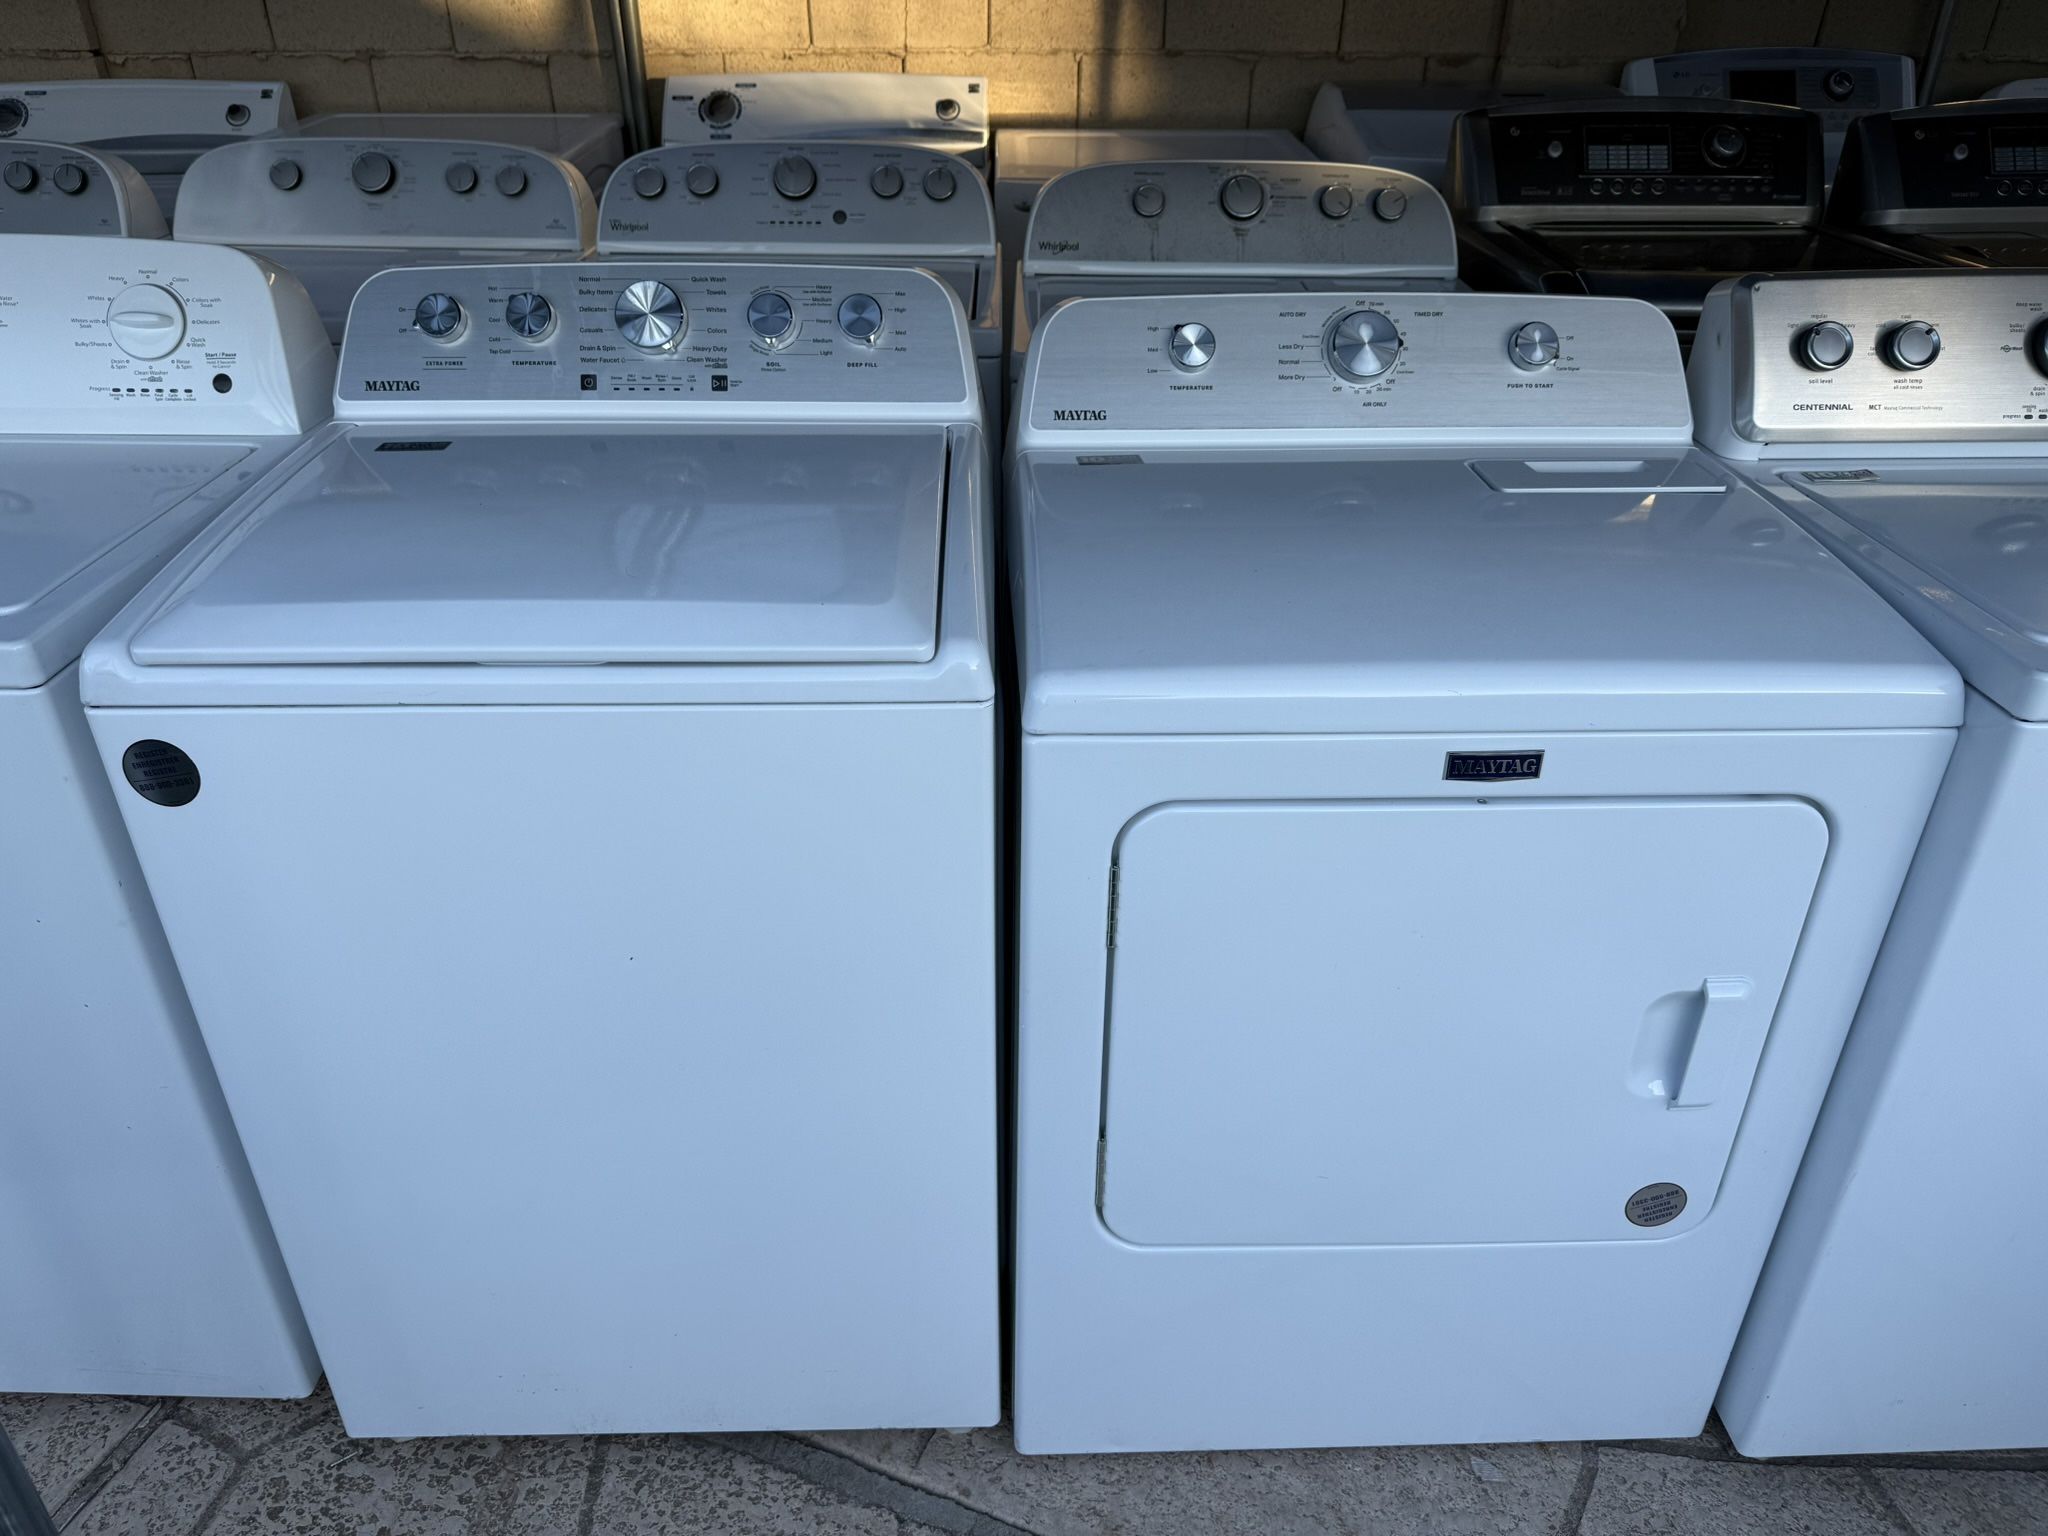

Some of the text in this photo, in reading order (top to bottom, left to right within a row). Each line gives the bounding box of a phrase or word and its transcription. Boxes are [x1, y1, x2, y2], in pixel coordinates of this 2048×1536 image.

[609, 219, 649, 232] Whirlpool
[1039, 240, 1079, 255] Whirlpool
[365, 380, 420, 391] MAYTAG
[1054, 410, 1107, 421] MAYTAG
[1452, 759, 1537, 775] MAYTAG
